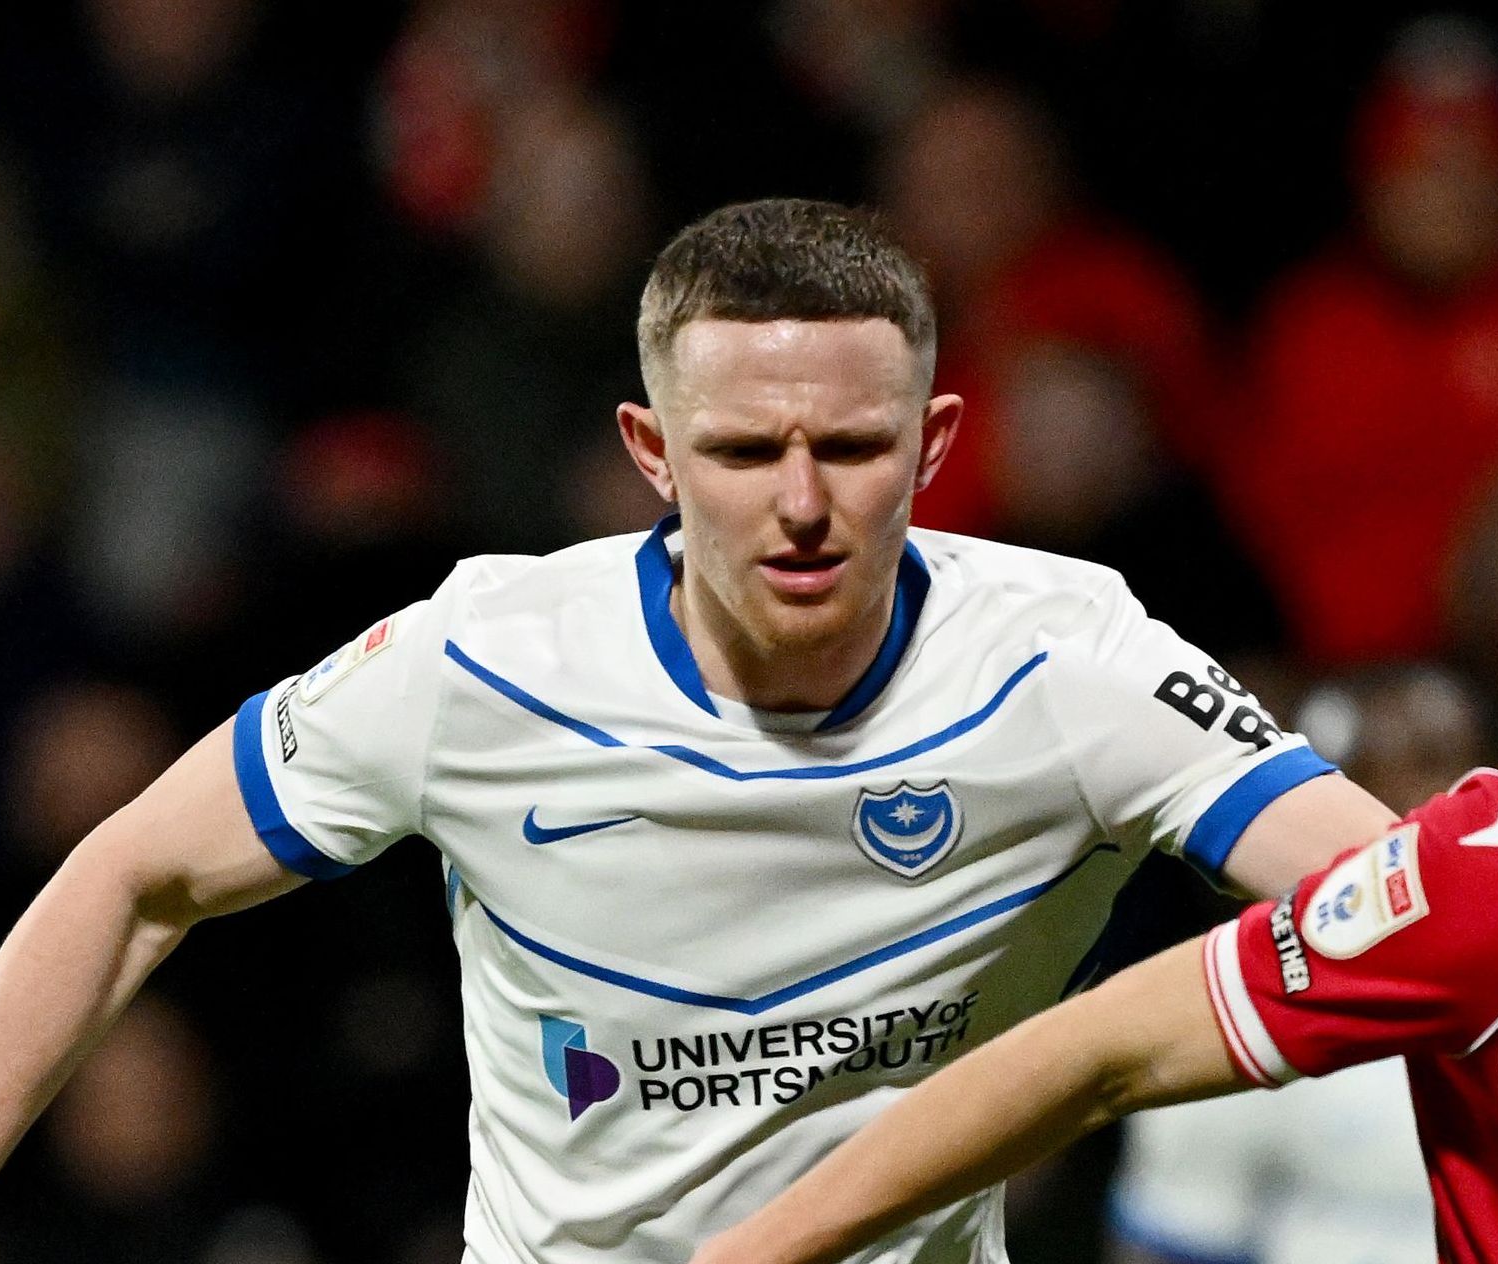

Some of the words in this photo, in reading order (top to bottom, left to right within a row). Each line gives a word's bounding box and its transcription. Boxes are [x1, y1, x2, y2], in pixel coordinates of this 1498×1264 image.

[1270, 886, 1311, 993] GETHER
[632, 1000, 941, 1073] UNIVERSITY
[938, 991, 979, 1026] OF
